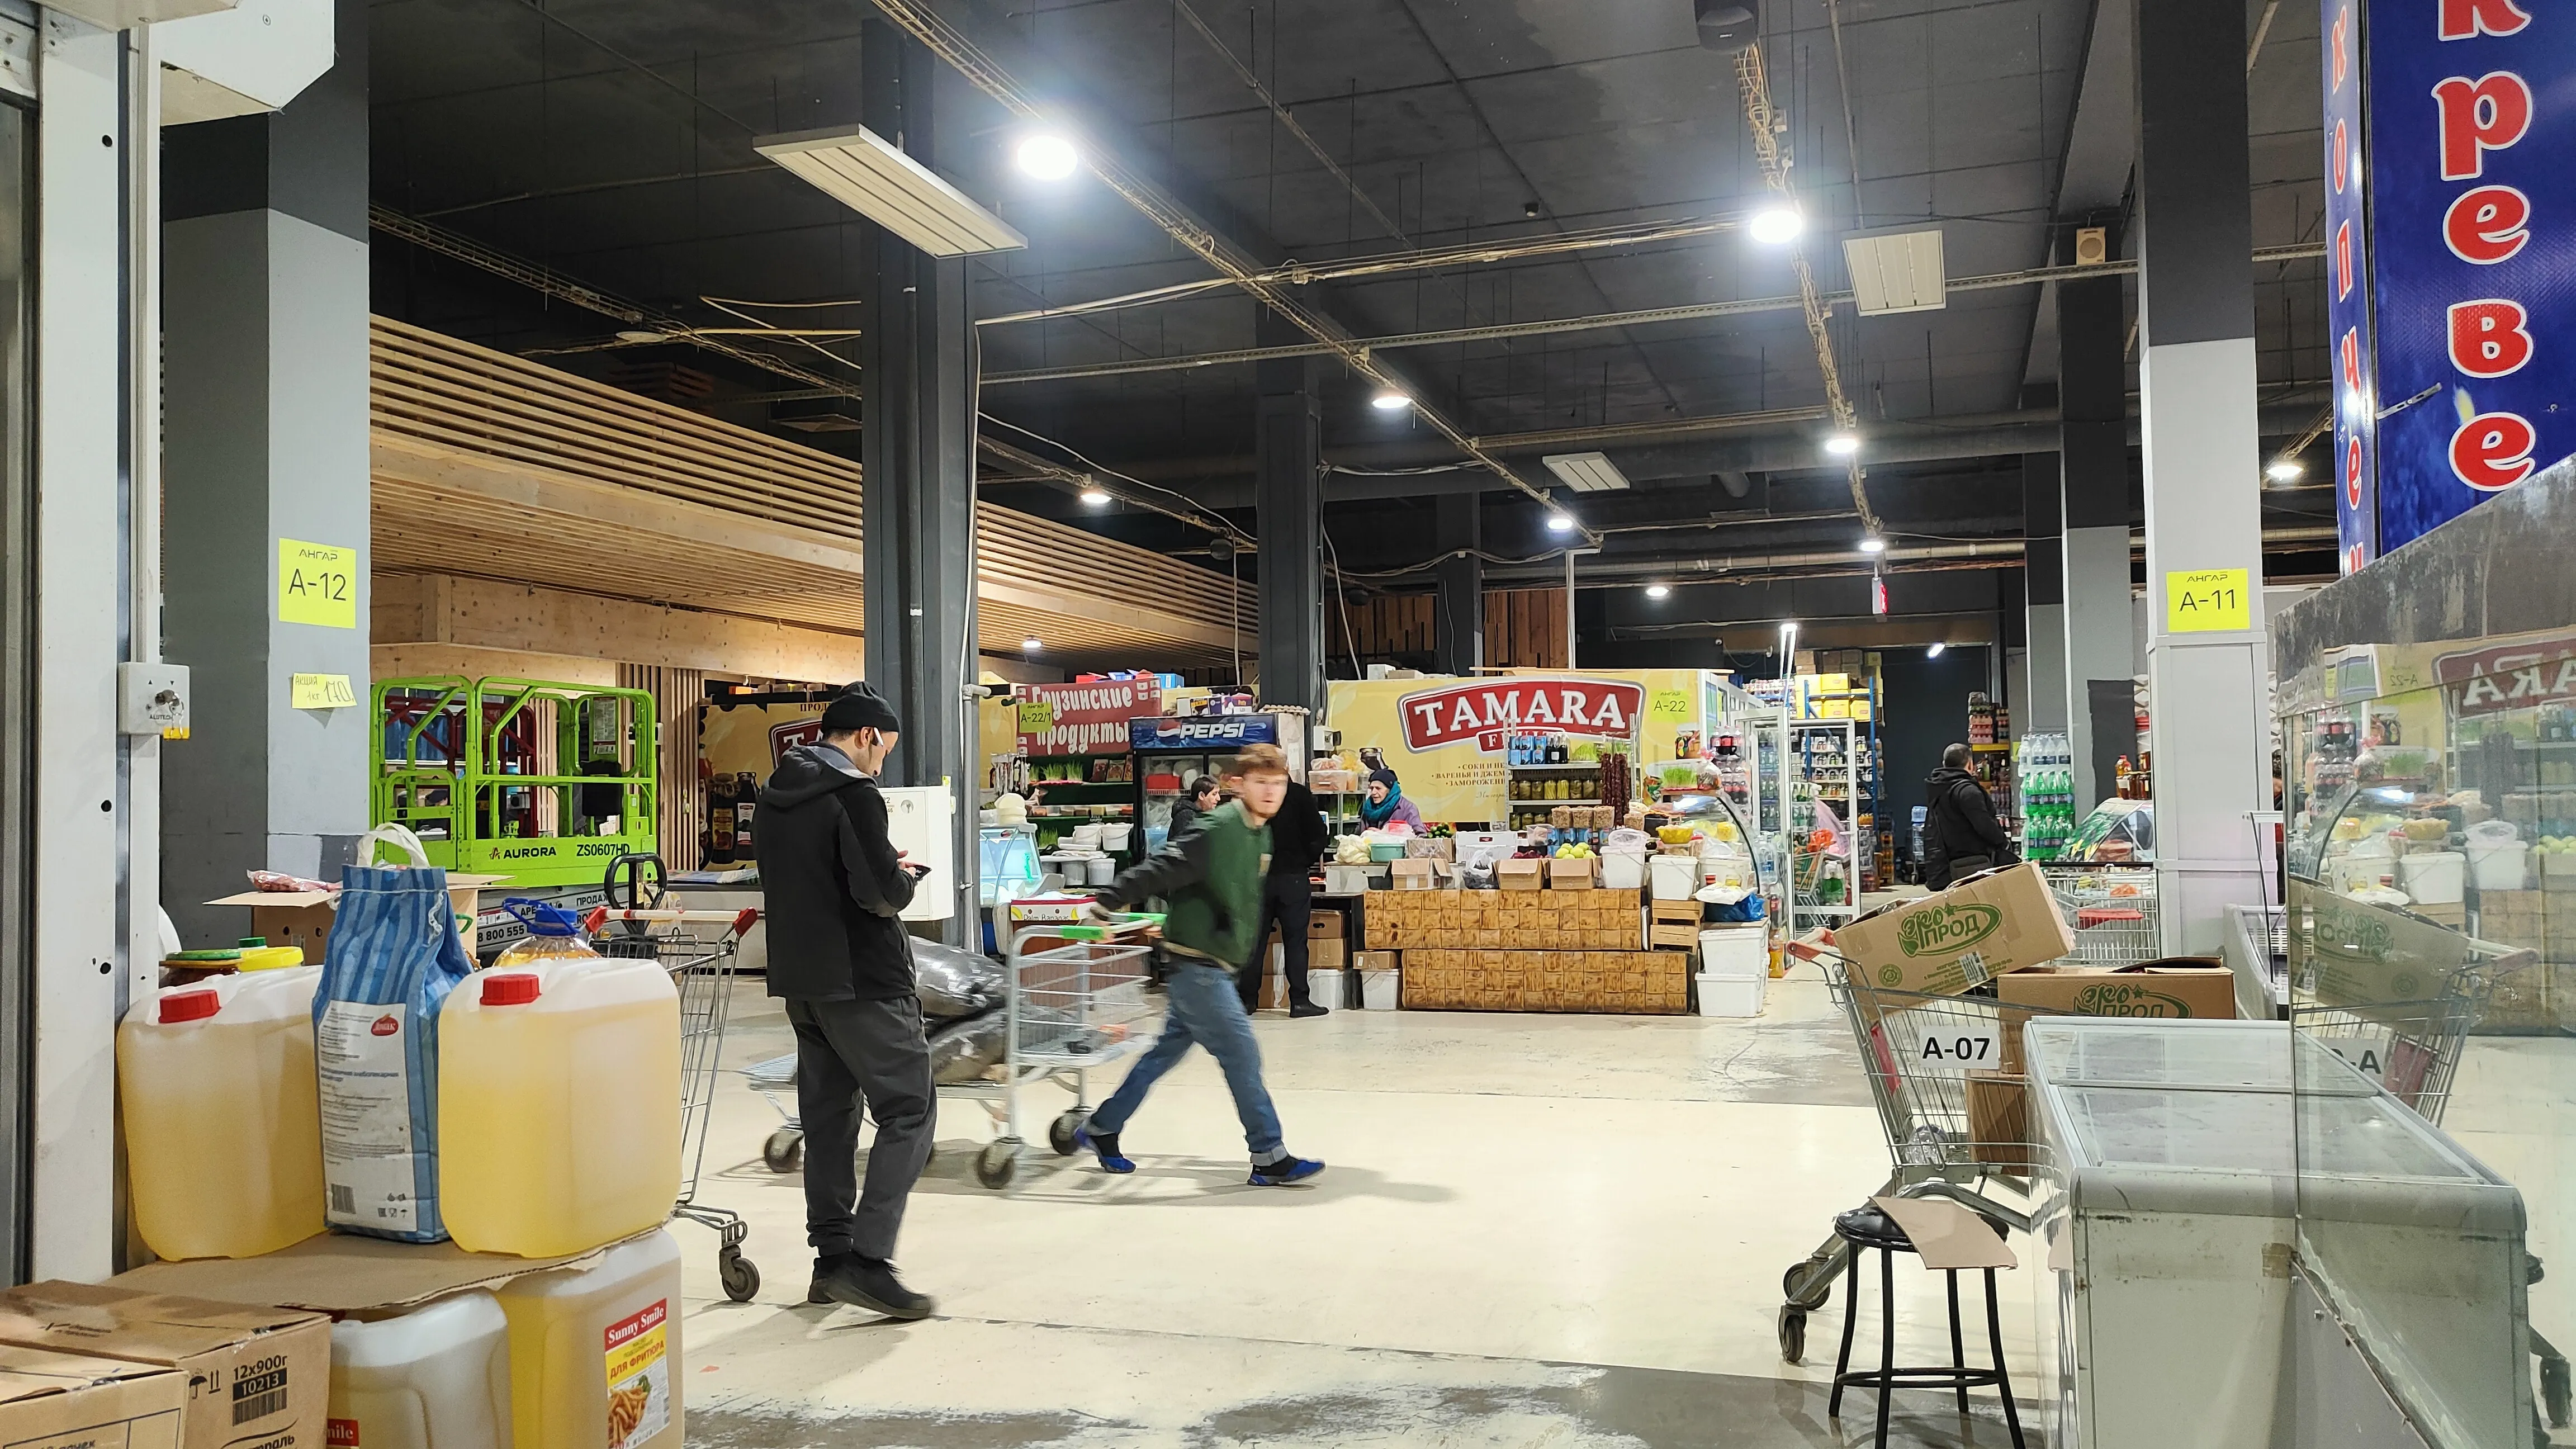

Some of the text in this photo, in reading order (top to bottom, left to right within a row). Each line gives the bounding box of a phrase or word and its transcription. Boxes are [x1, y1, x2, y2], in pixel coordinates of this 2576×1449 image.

[299, 549, 338, 561] АНГАР
[2187, 574, 2228, 583] АНГАР
[1414, 689, 1626, 737] TAMARA
[1180, 723, 1246, 738] PEPSI
[504, 843, 630, 859] AURORA ZS0607HD
[577, 894, 608, 906] ПРОДАЖ
[486, 929, 504, 940] 800
[507, 925, 524, 937] 555
[1925, 914, 1980, 947] ПРОД
[608, 1306, 664, 1344] Sunny Smile
[610, 1361, 627, 1380] ДЛЯ
[629, 1340, 665, 1367] ФРИТЮРА
[242, 1374, 280, 1396] 10213
